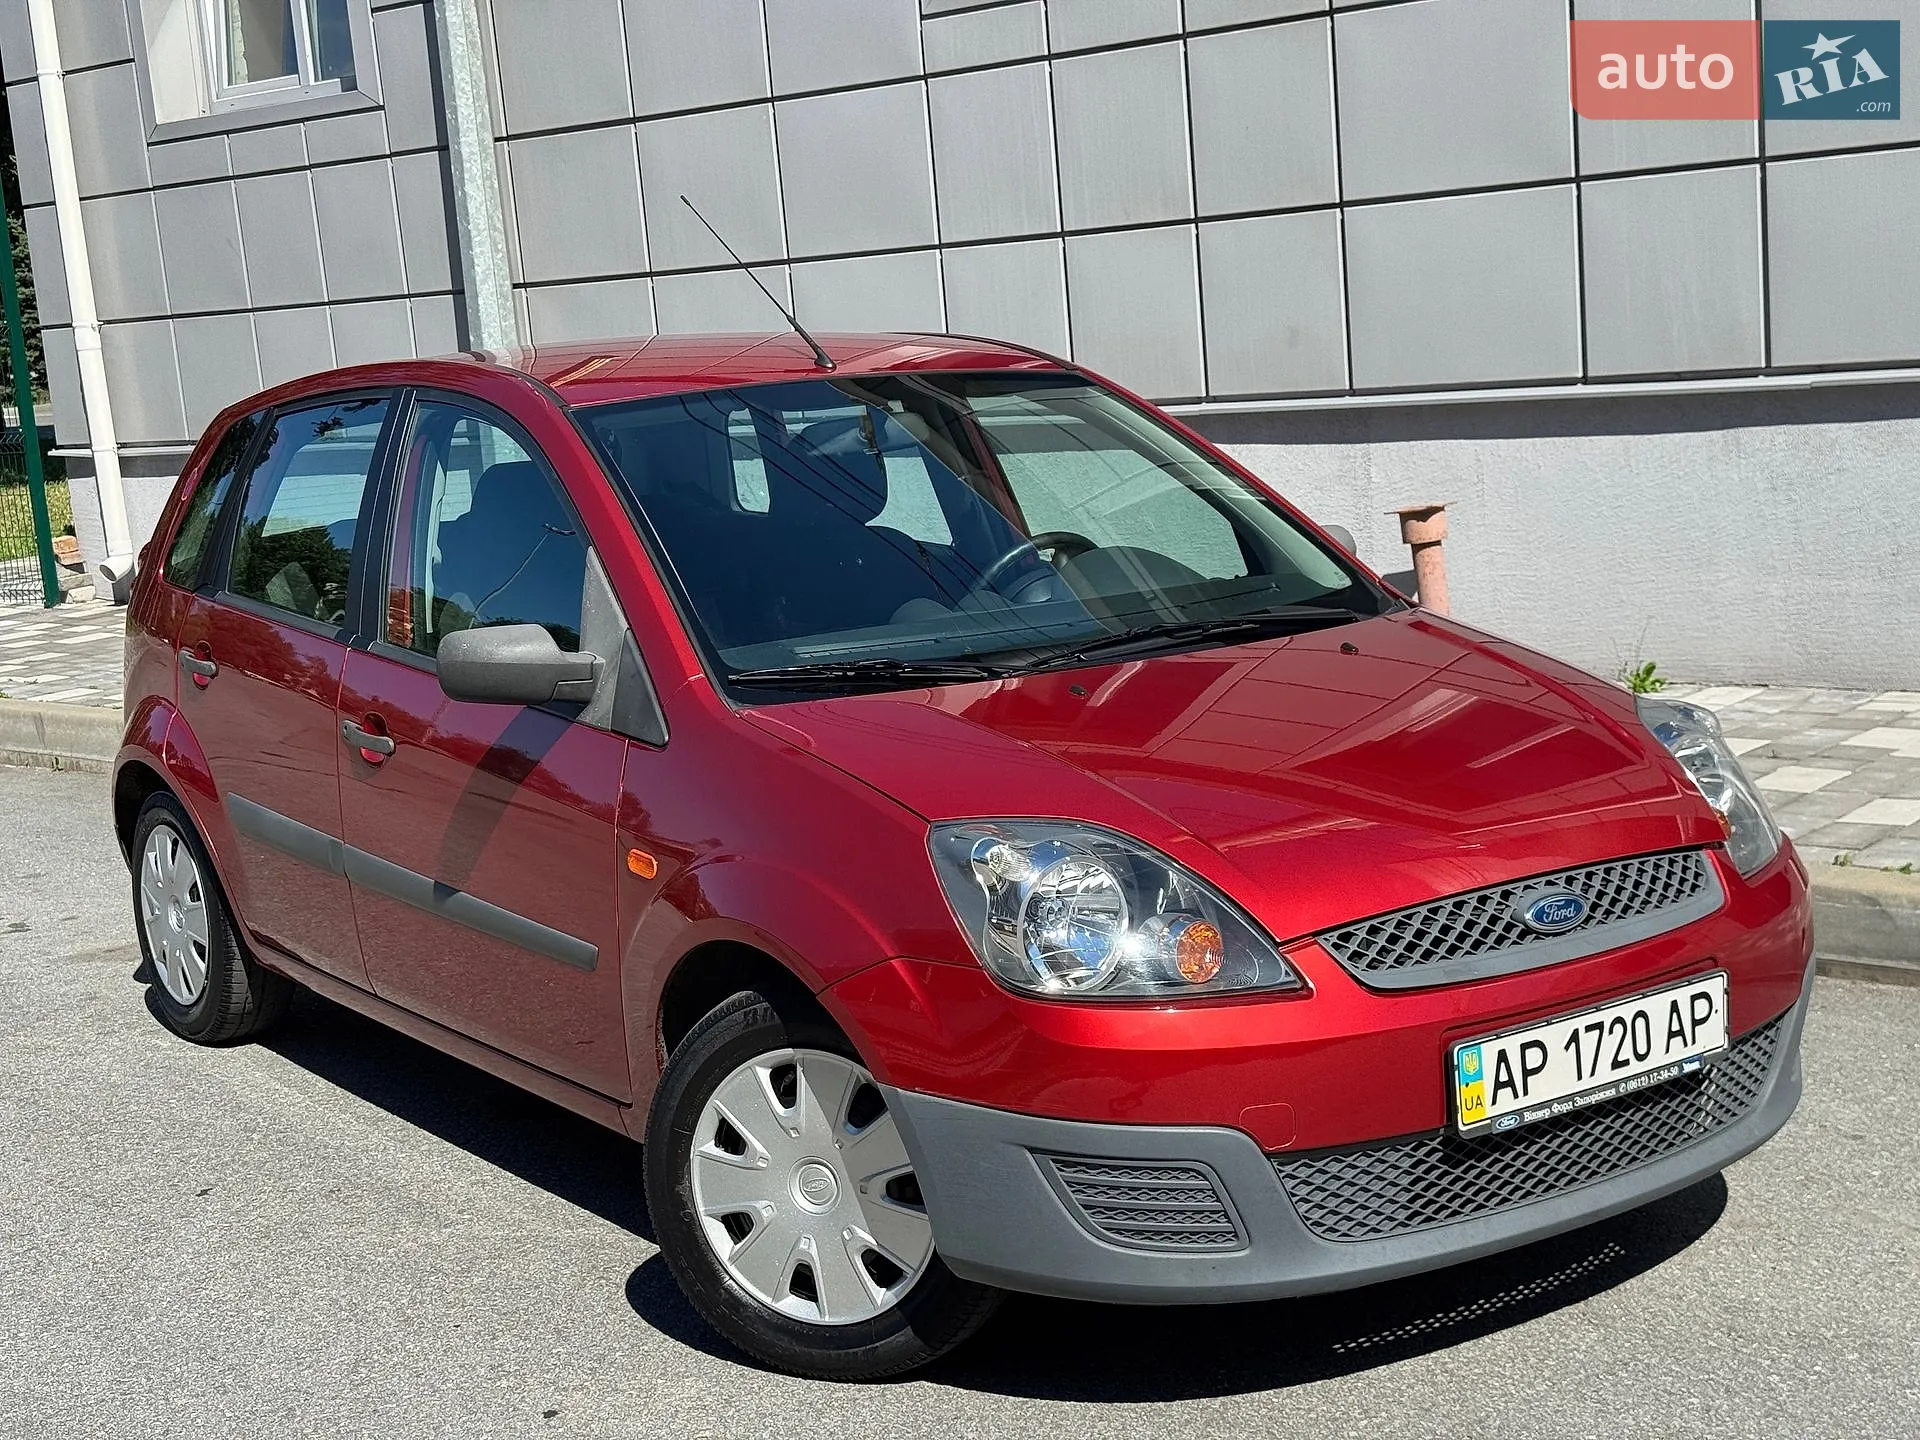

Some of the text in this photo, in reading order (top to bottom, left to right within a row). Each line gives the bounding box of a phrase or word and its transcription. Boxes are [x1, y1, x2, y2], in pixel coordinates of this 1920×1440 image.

[1543, 900, 1576, 923] Ford
[1491, 991, 1714, 1106] AP 1720 AP
[1464, 1097, 1484, 1112] UA
